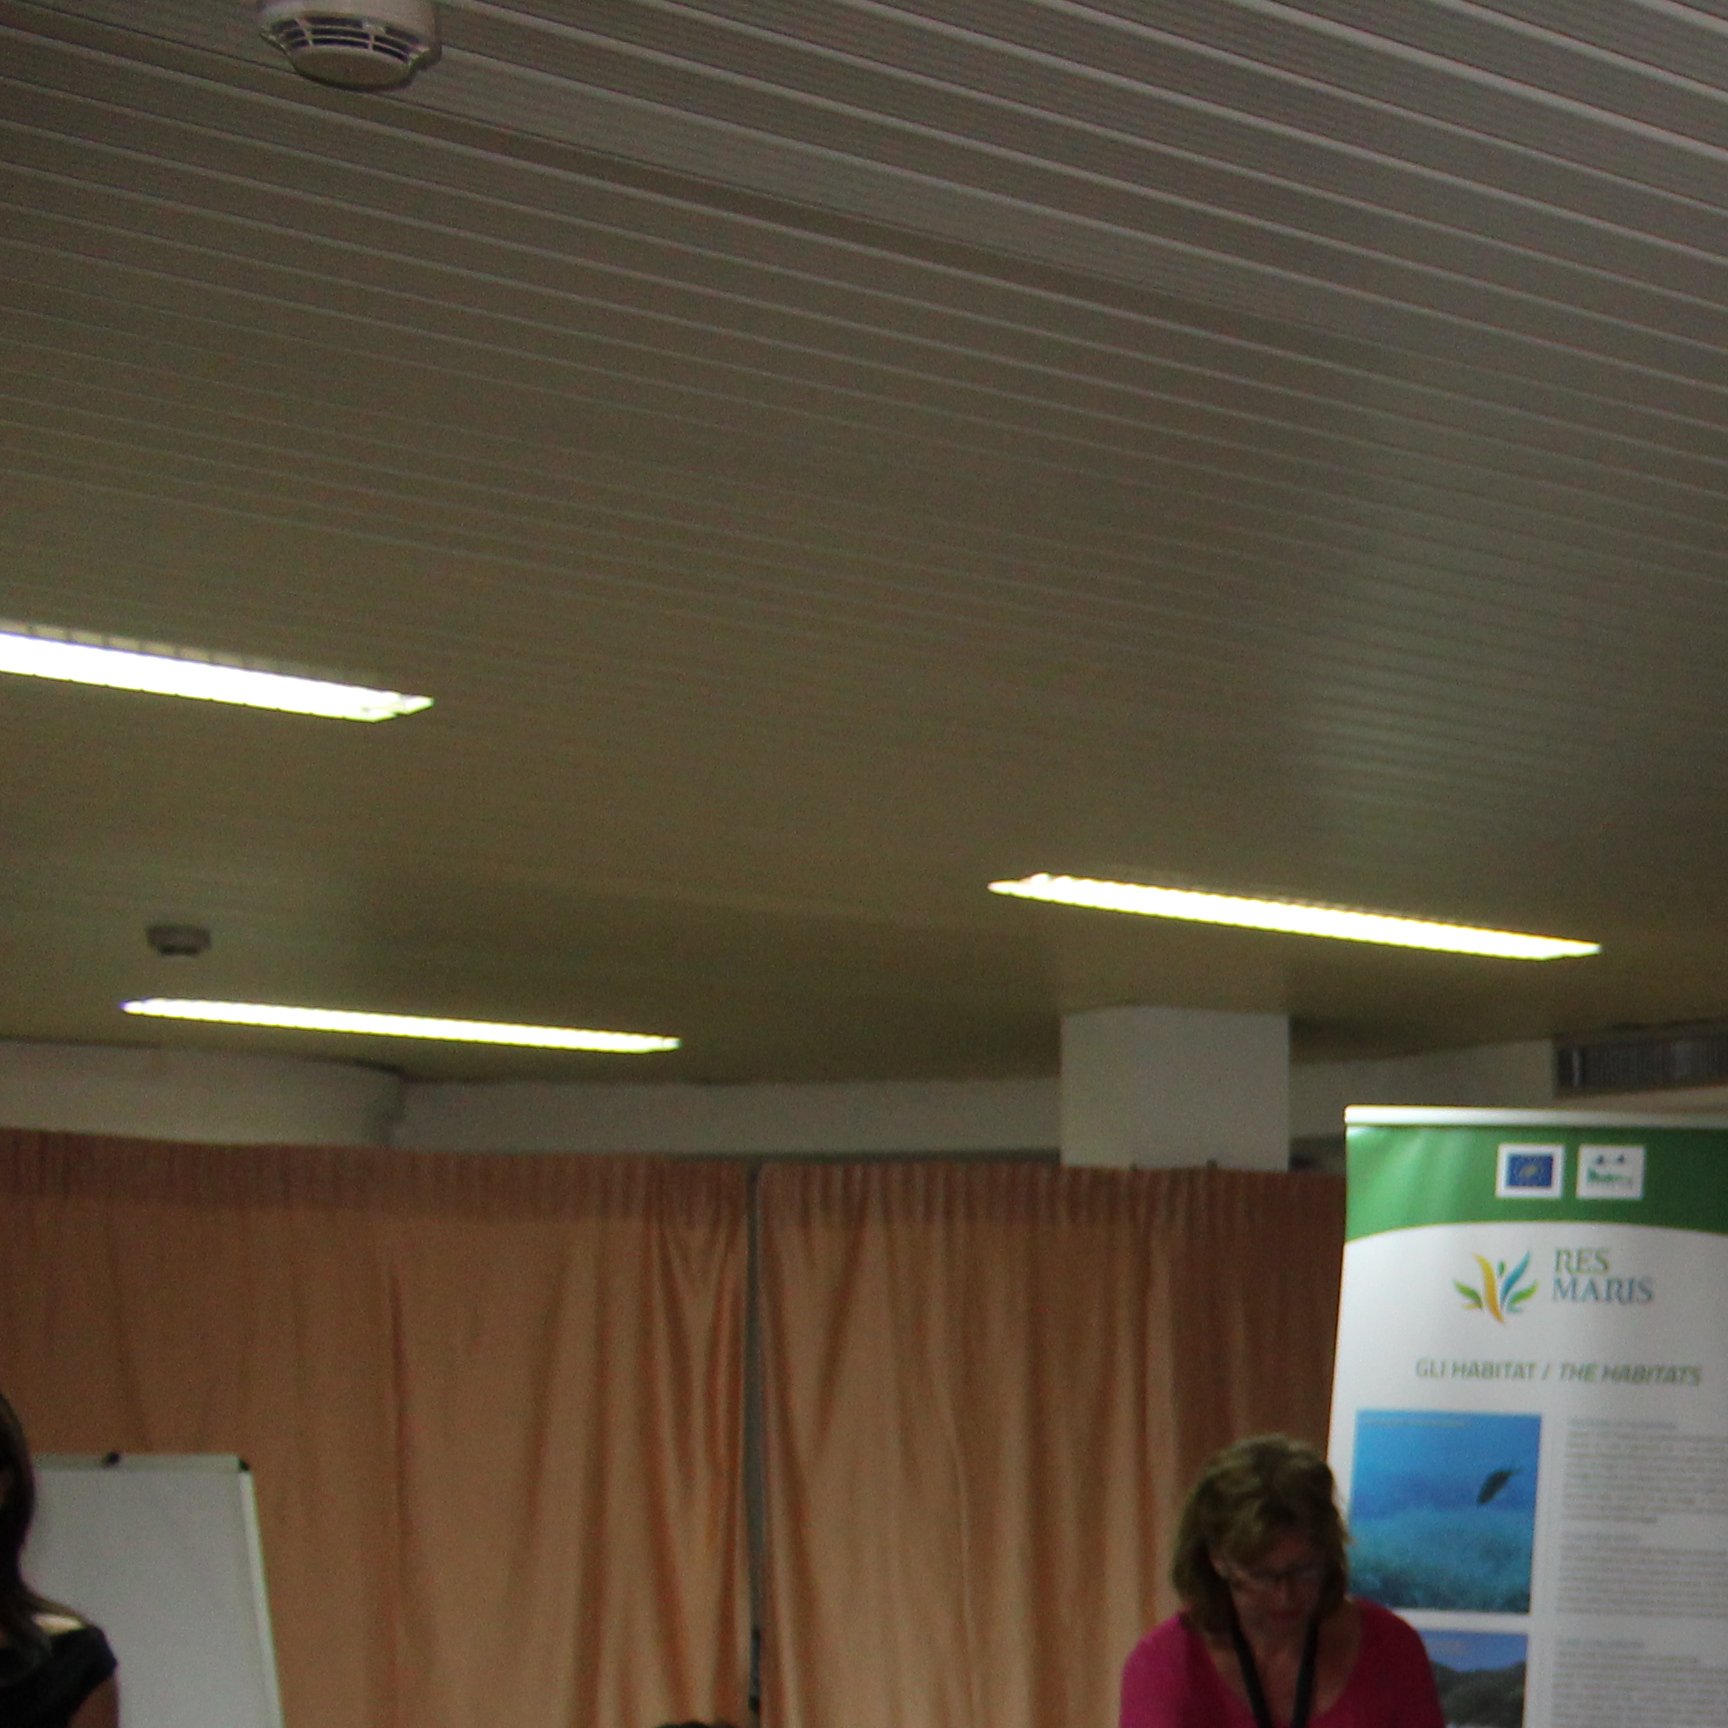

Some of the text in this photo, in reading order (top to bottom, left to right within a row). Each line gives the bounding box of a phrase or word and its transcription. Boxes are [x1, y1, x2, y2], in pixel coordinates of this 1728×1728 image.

[1554, 1249, 1610, 1274] RES
[1553, 1277, 1653, 1305] MARIS
[1415, 1359, 1446, 1378] GLI
[1451, 1361, 1539, 1380] HABITAT
[1559, 1363, 1597, 1382] THE
[1602, 1364, 1702, 1386] HABITATS
